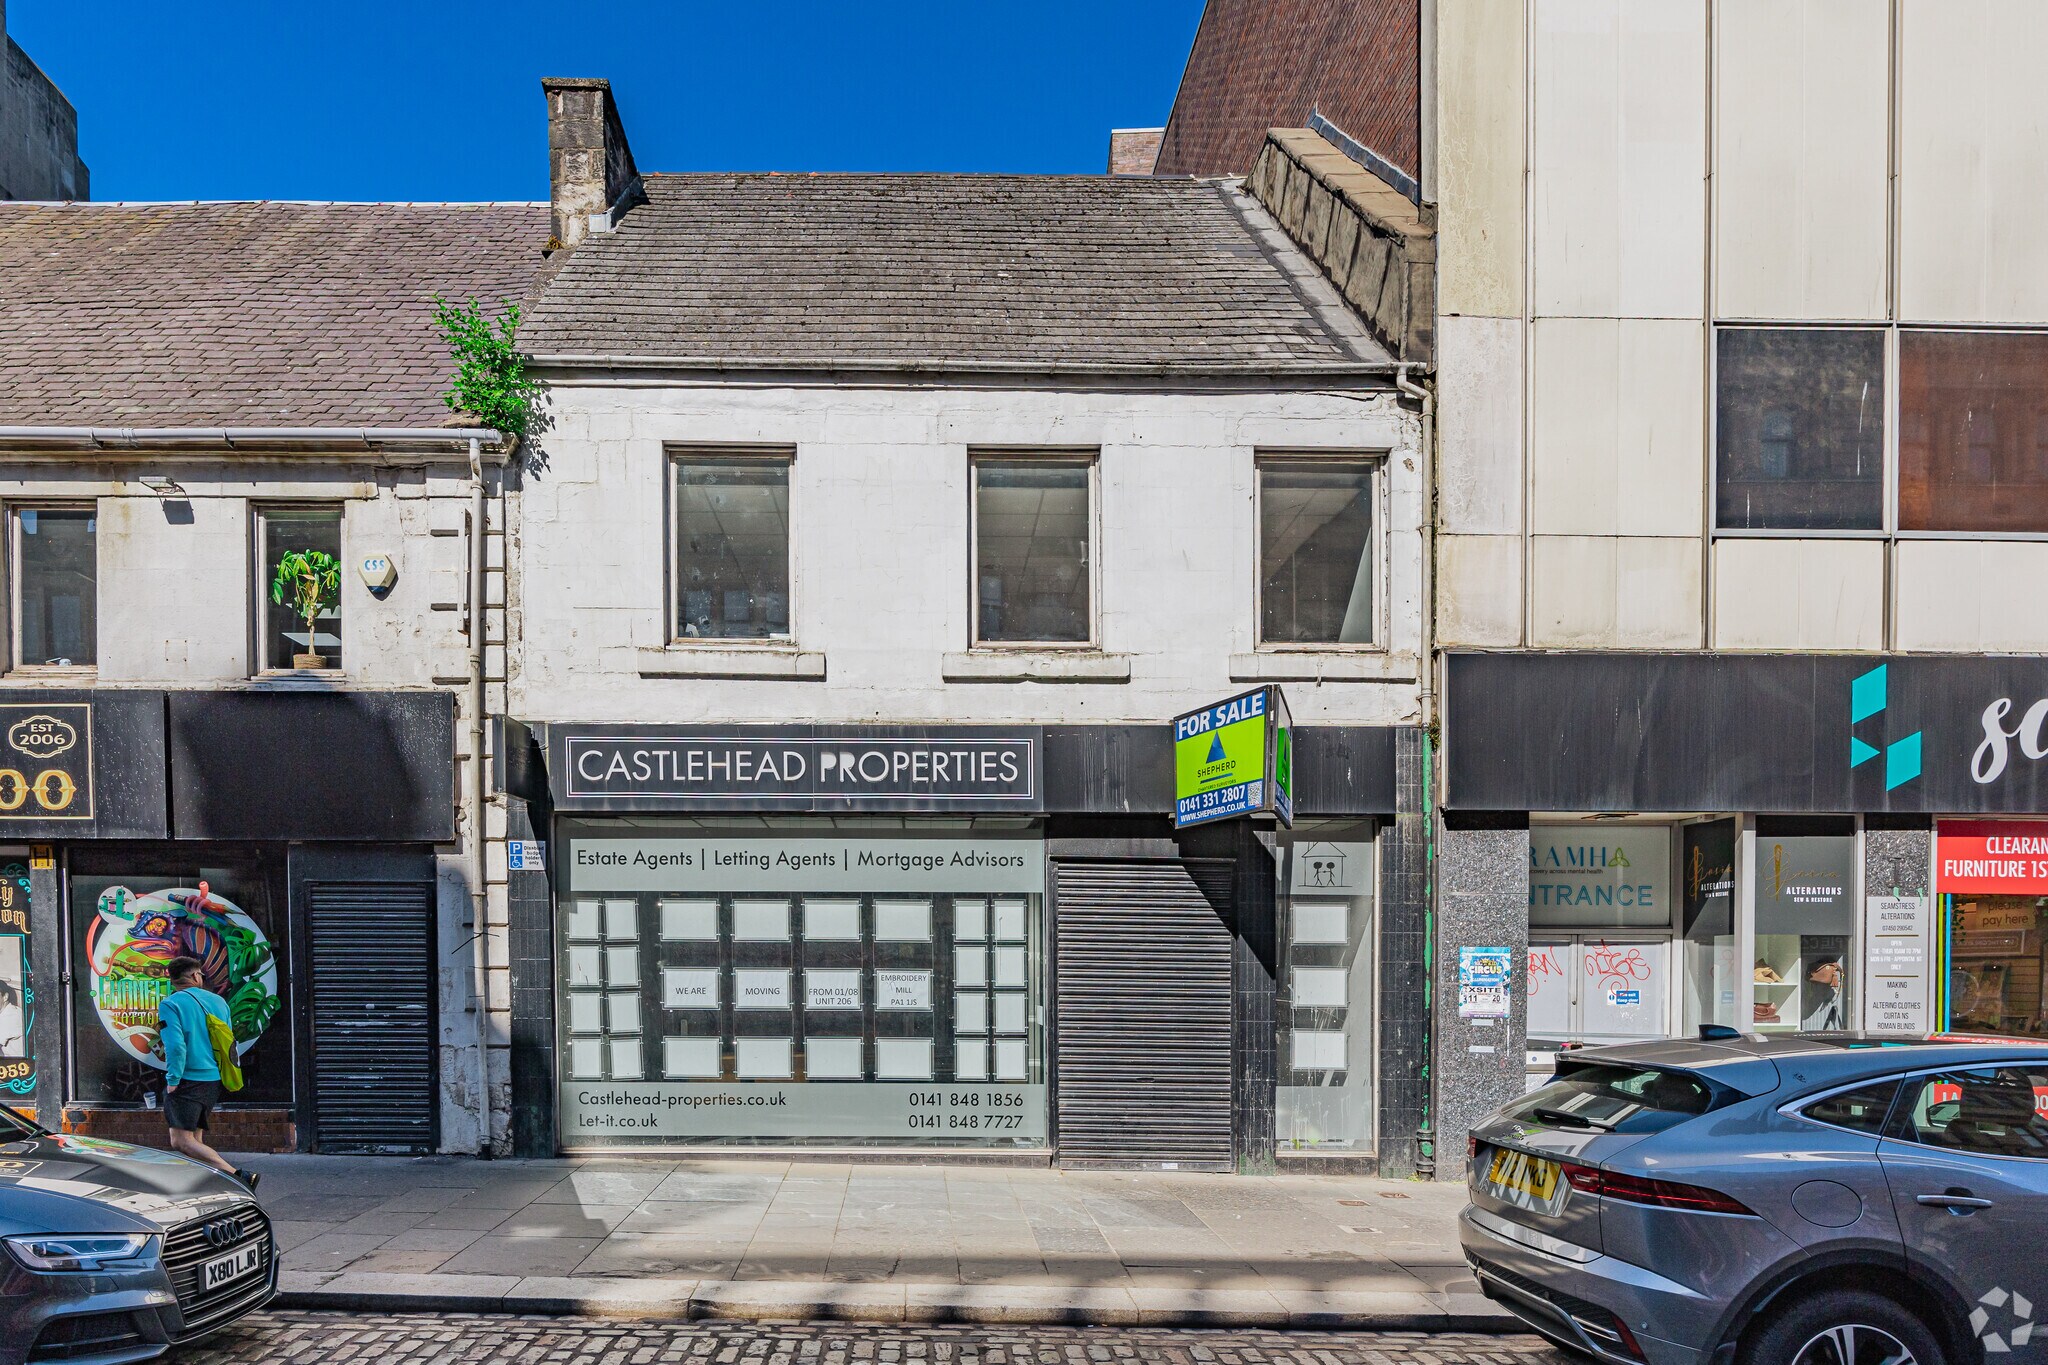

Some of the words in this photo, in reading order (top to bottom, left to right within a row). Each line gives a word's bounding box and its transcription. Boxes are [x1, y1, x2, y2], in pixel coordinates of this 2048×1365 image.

[364, 559, 385, 571] CSS
[1178, 710, 1210, 739] FOR
[1215, 692, 1263, 727] SALE
[31, 723, 54, 732] EST
[20, 734, 65, 745] 2006
[577, 750, 805, 782] CASTLEHEAD
[820, 751, 1018, 783] PROPERTIES
[1197, 760, 1236, 778] SHEPHERD
[1180, 795, 1200, 812] 0141
[1203, 791, 1219, 808] 331
[1222, 785, 1245, 803] 2807
[512, 843, 521, 853] P
[577, 849, 627, 866] Estate
[633, 849, 692, 871] Agents
[714, 850, 770, 871] Letting
[776, 850, 836, 871] Agents
[857, 850, 945, 872] Mortgage
[950, 849, 1025, 868] Advisors
[1945, 860, 2026, 877] FURNITURE
[1701, 881, 1735, 891] ALTERATIONS
[1786, 886, 1842, 896] ALTERATIONS
[1988, 900, 2023, 913] please
[1982, 916, 2002, 928] pay
[2005, 915, 2029, 925] here
[1468, 965, 1503, 975] CIRCUS
[881, 974, 927, 982] EMBROIDERY
[896, 986, 912, 994] MILL
[1887, 981, 1907, 989] MAKING
[675, 987, 689, 995] WE
[691, 987, 706, 995] ARE
[745, 987, 781, 995] MOVING
[808, 988, 832, 996] FROM
[834, 987, 858, 996] 01/08
[1468, 994, 1478, 1002] 11
[113, 1012, 159, 1025] TATTO
[1877, 1022, 1896, 1030] ROMAN
[1897, 1022, 1915, 1030] BLINDS
[579, 1091, 787, 1109] Castlehead-properties.co.uk
[909, 1093, 942, 1106] 0141
[950, 1093, 979, 1106] 848
[987, 1093, 1023, 1107] 1856
[579, 1113, 658, 1128] Let-it.co.uk
[908, 1115, 941, 1128] 0141
[949, 1115, 978, 1128] 848
[984, 1115, 1023, 1128] 7727
[236, 1249, 257, 1274] LJR
